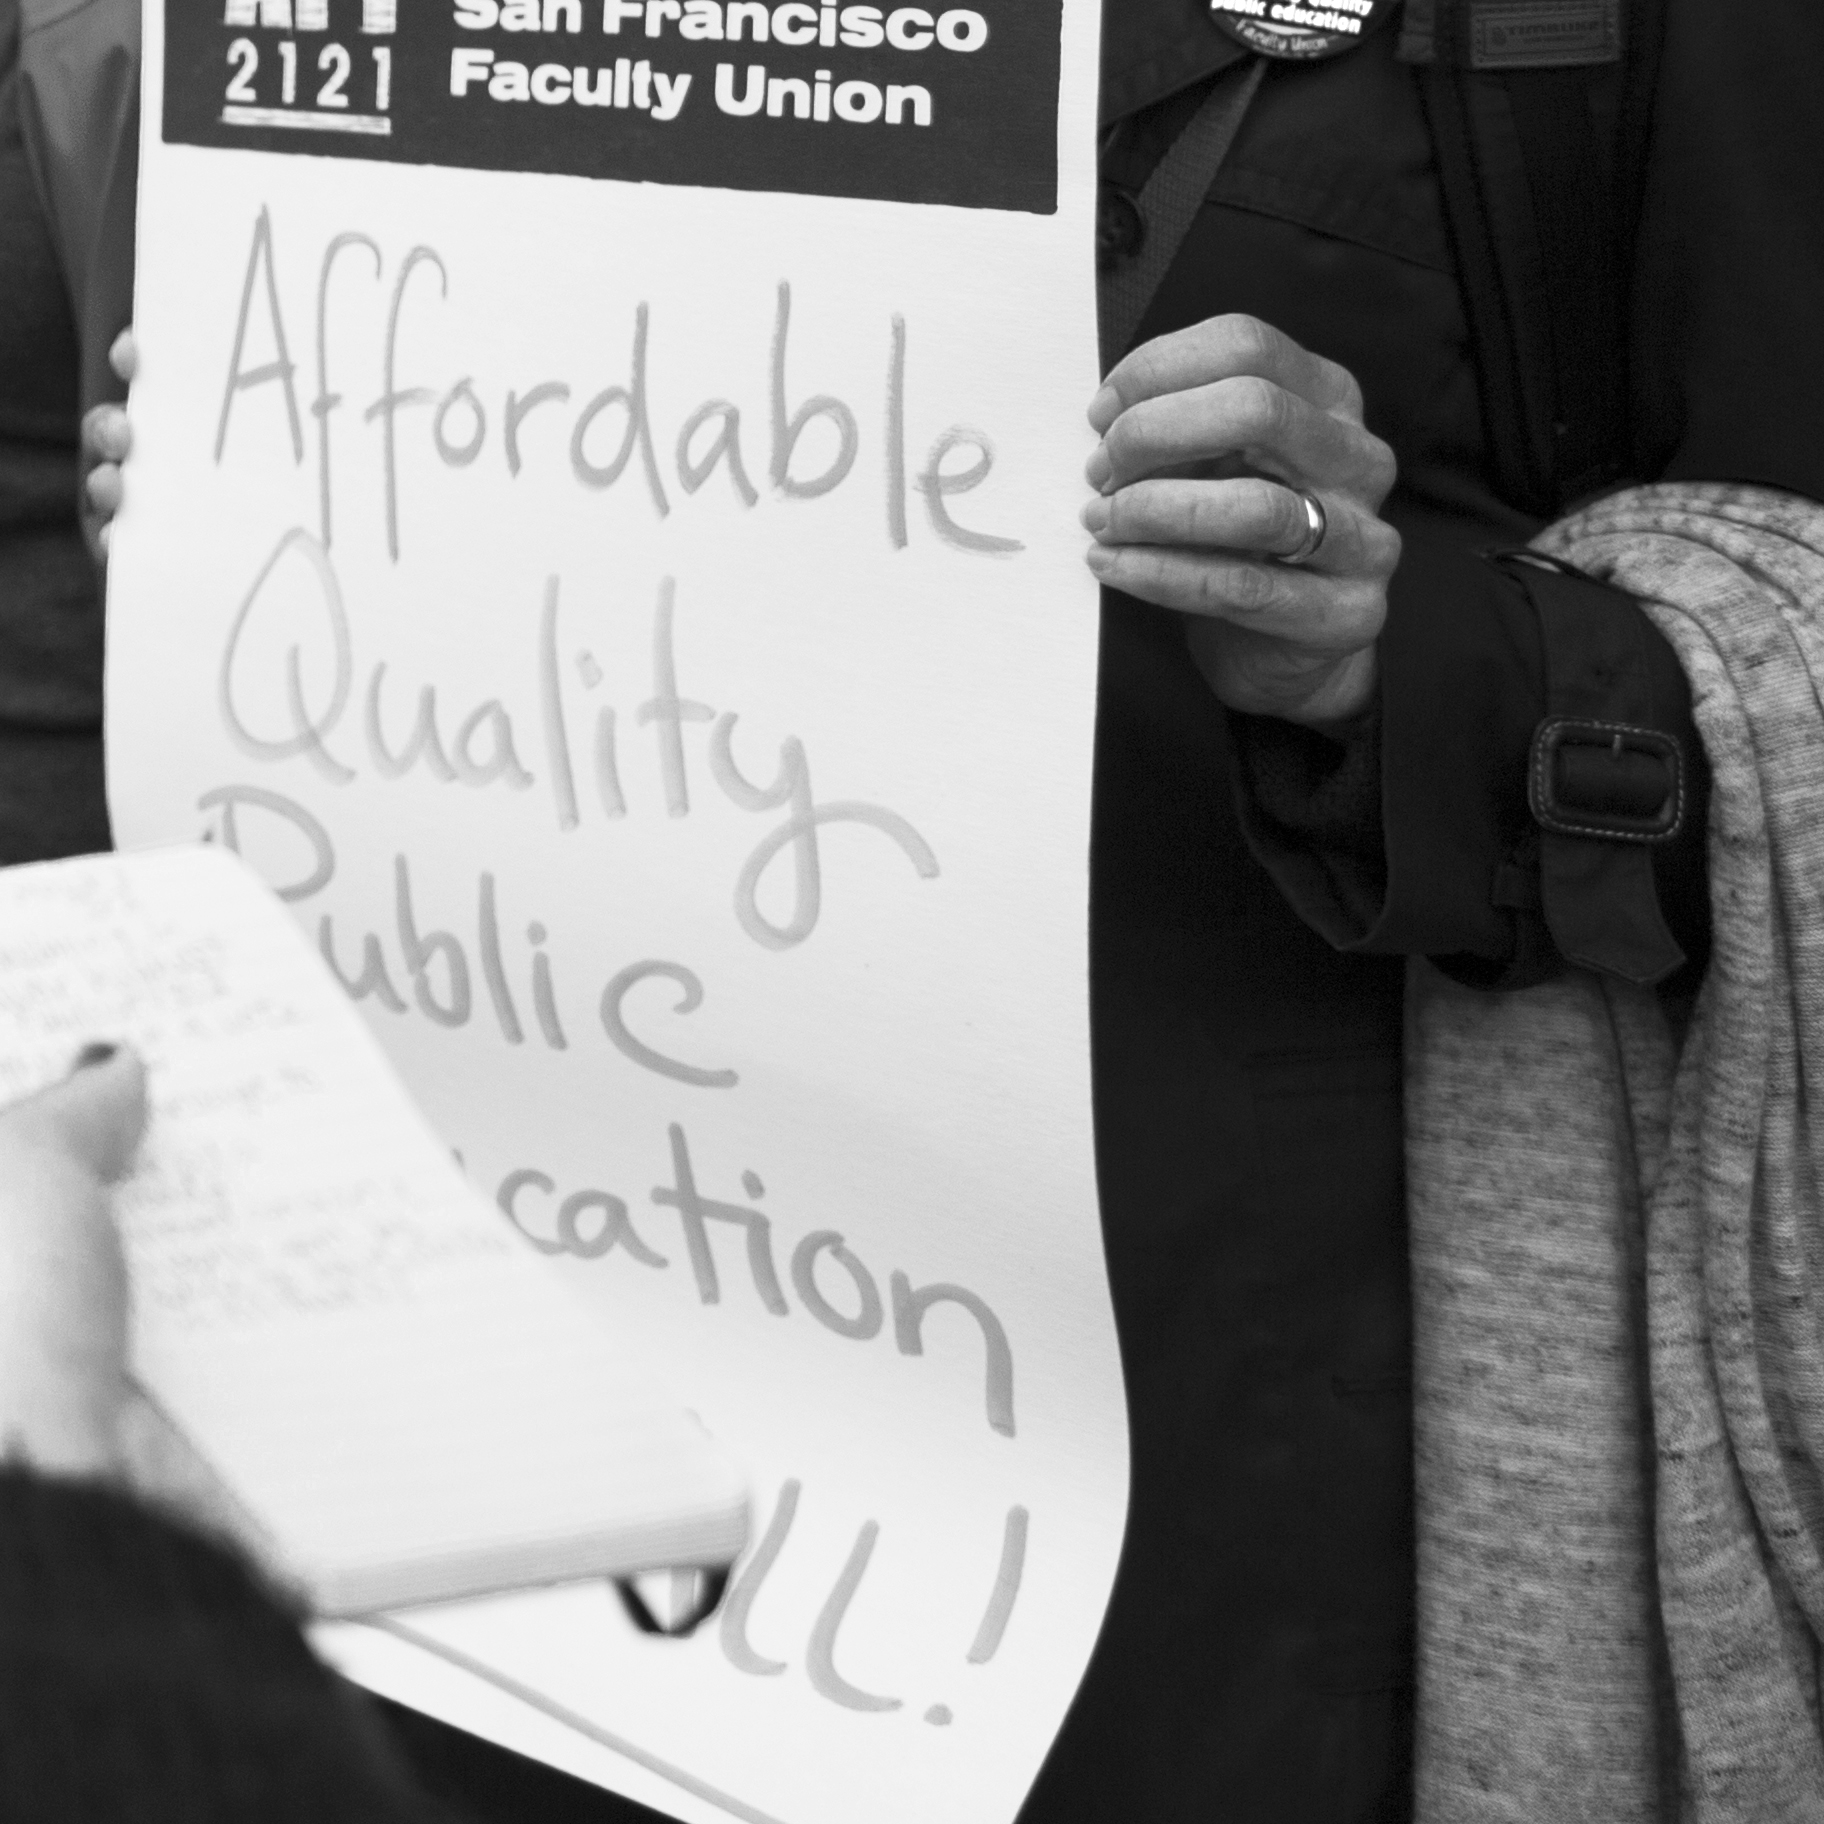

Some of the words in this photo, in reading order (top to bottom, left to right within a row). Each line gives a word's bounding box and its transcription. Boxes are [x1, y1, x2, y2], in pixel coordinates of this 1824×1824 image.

[224, 37, 393, 112] 2121
[448, 47, 692, 120] Faculty
[713, 62, 933, 127] Union
[1270, 4, 1362, 35] education
[214, 202, 1027, 564] Affordable
[218, 526, 942, 952] Quality
[197, 783, 739, 1086] Public
[450, 1121, 1016, 1439] cation
